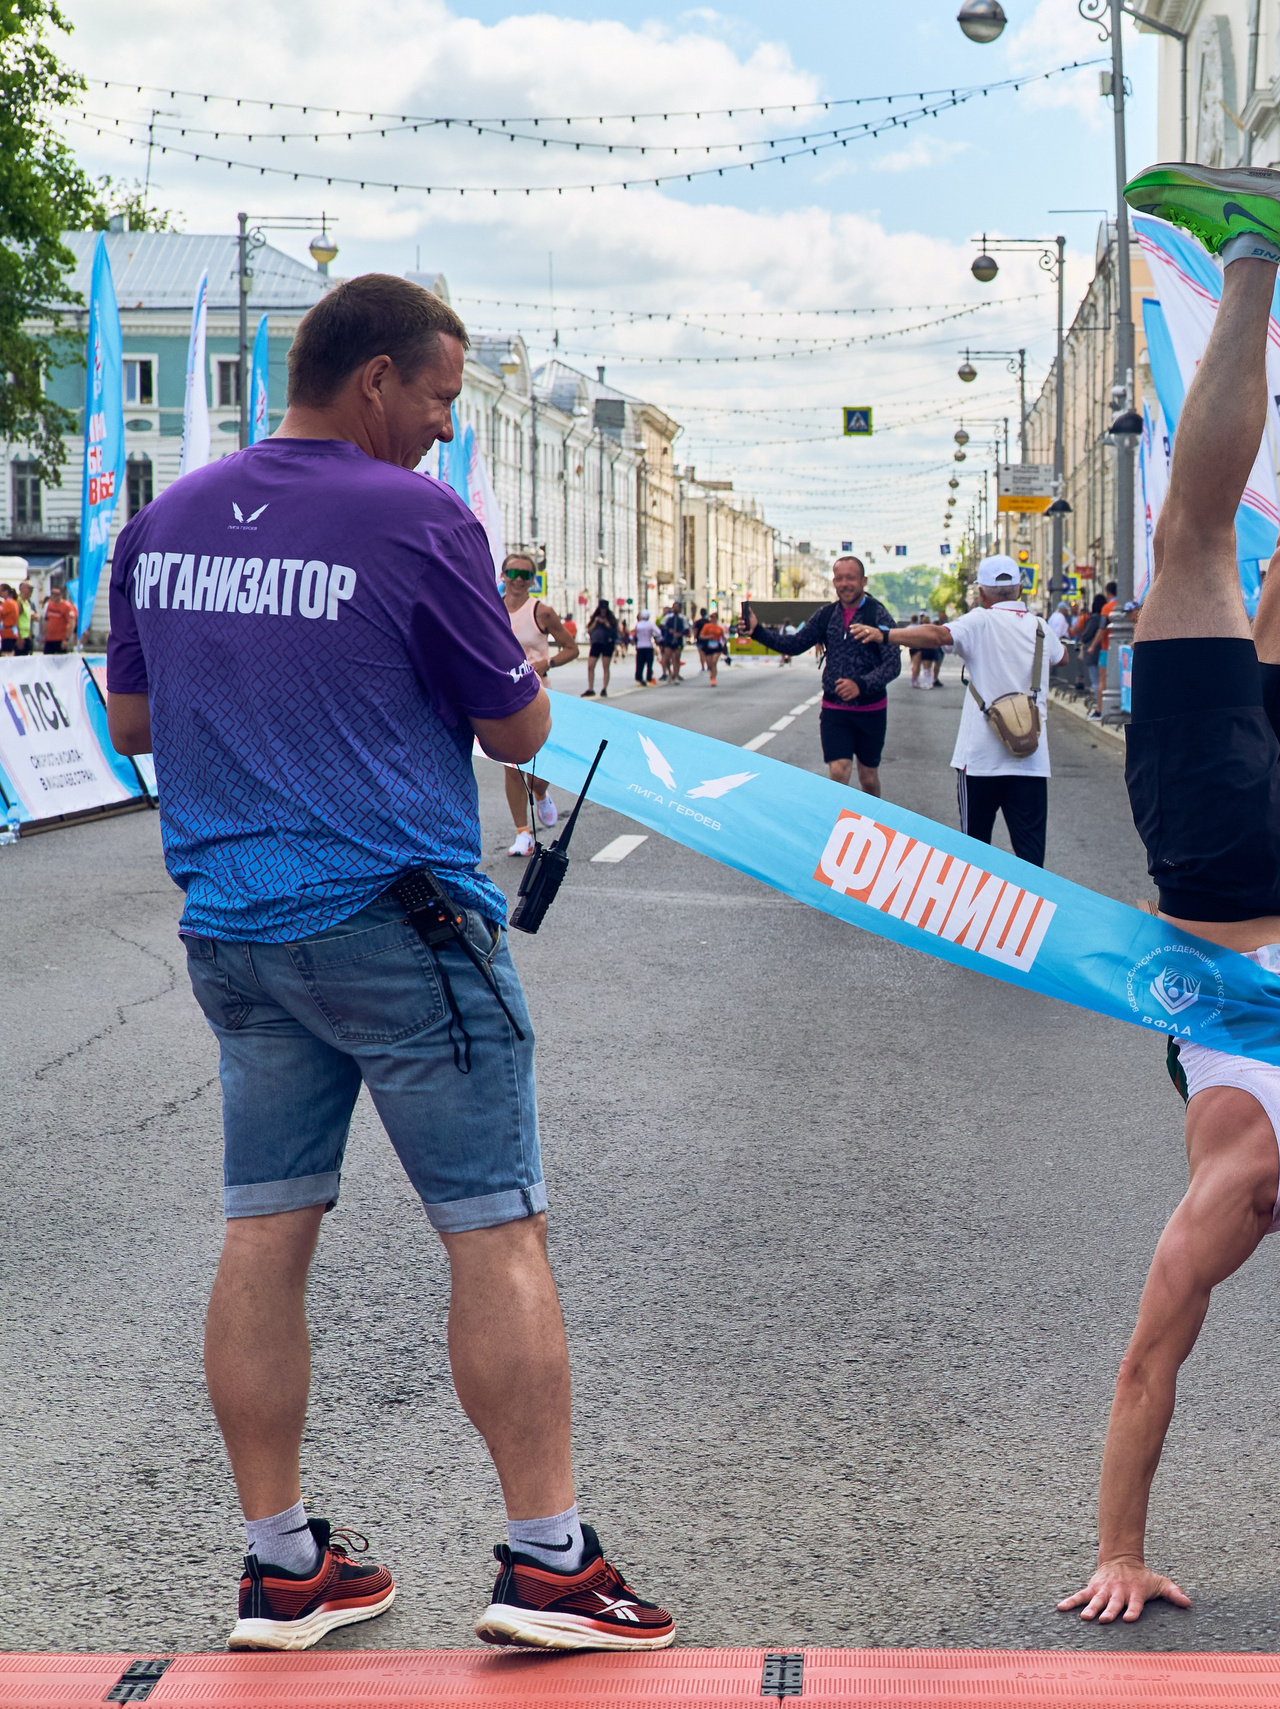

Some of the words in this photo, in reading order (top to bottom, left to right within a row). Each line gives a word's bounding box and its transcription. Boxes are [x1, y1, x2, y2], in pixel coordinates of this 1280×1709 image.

[133, 551, 357, 621] ОРГАНИЗАТОР
[626, 783, 663, 804] ЛИГА
[668, 800, 722, 831] ГЕРОЕВ
[820, 815, 1058, 973] ФИНИШ
[1126, 947, 1162, 1013] ВСЕРОССИЙСКАЯ
[1163, 944, 1216, 969] ФЕДЕРАЦИЯ
[1015, 1672, 1069, 1680] RACE
[1098, 1673, 1171, 1681] RESULT
